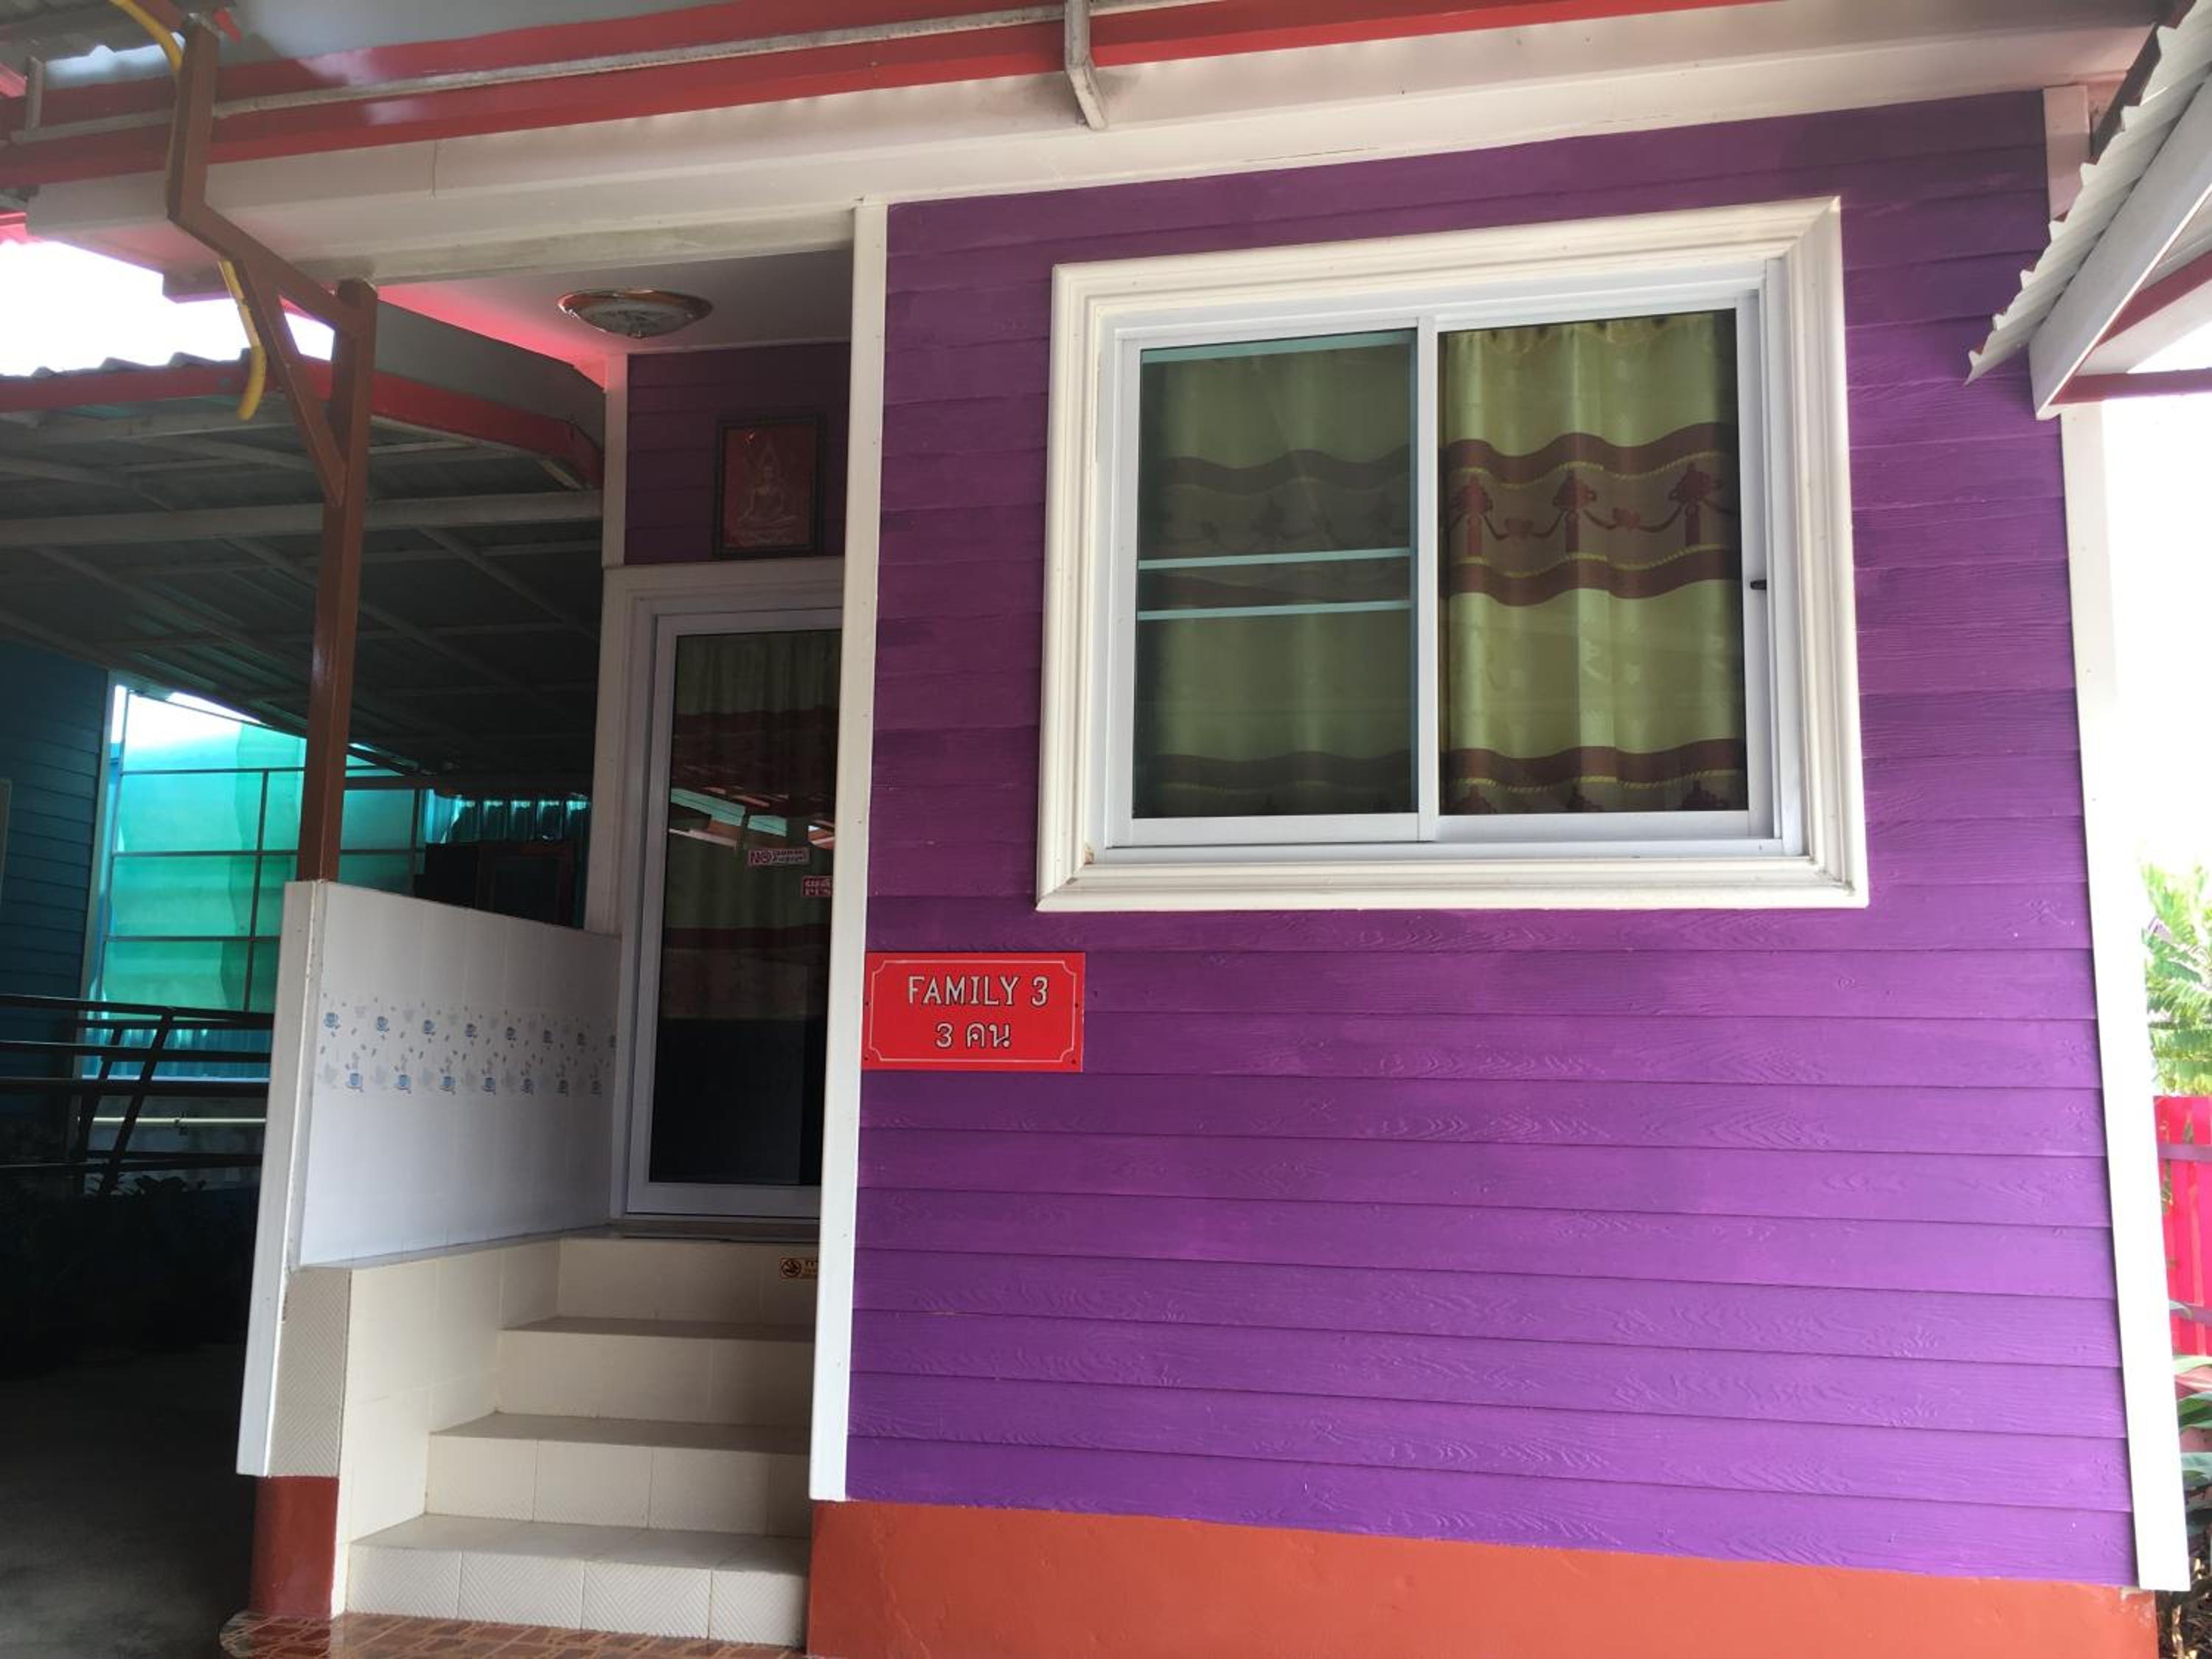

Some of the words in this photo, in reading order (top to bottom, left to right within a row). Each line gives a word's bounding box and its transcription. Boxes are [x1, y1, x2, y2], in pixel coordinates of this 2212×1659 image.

[907, 975, 1019, 1005] FAMILY
[1032, 975, 1049, 1006] 3
[936, 1023, 953, 1048] 3
[966, 1023, 1012, 1048] คน
